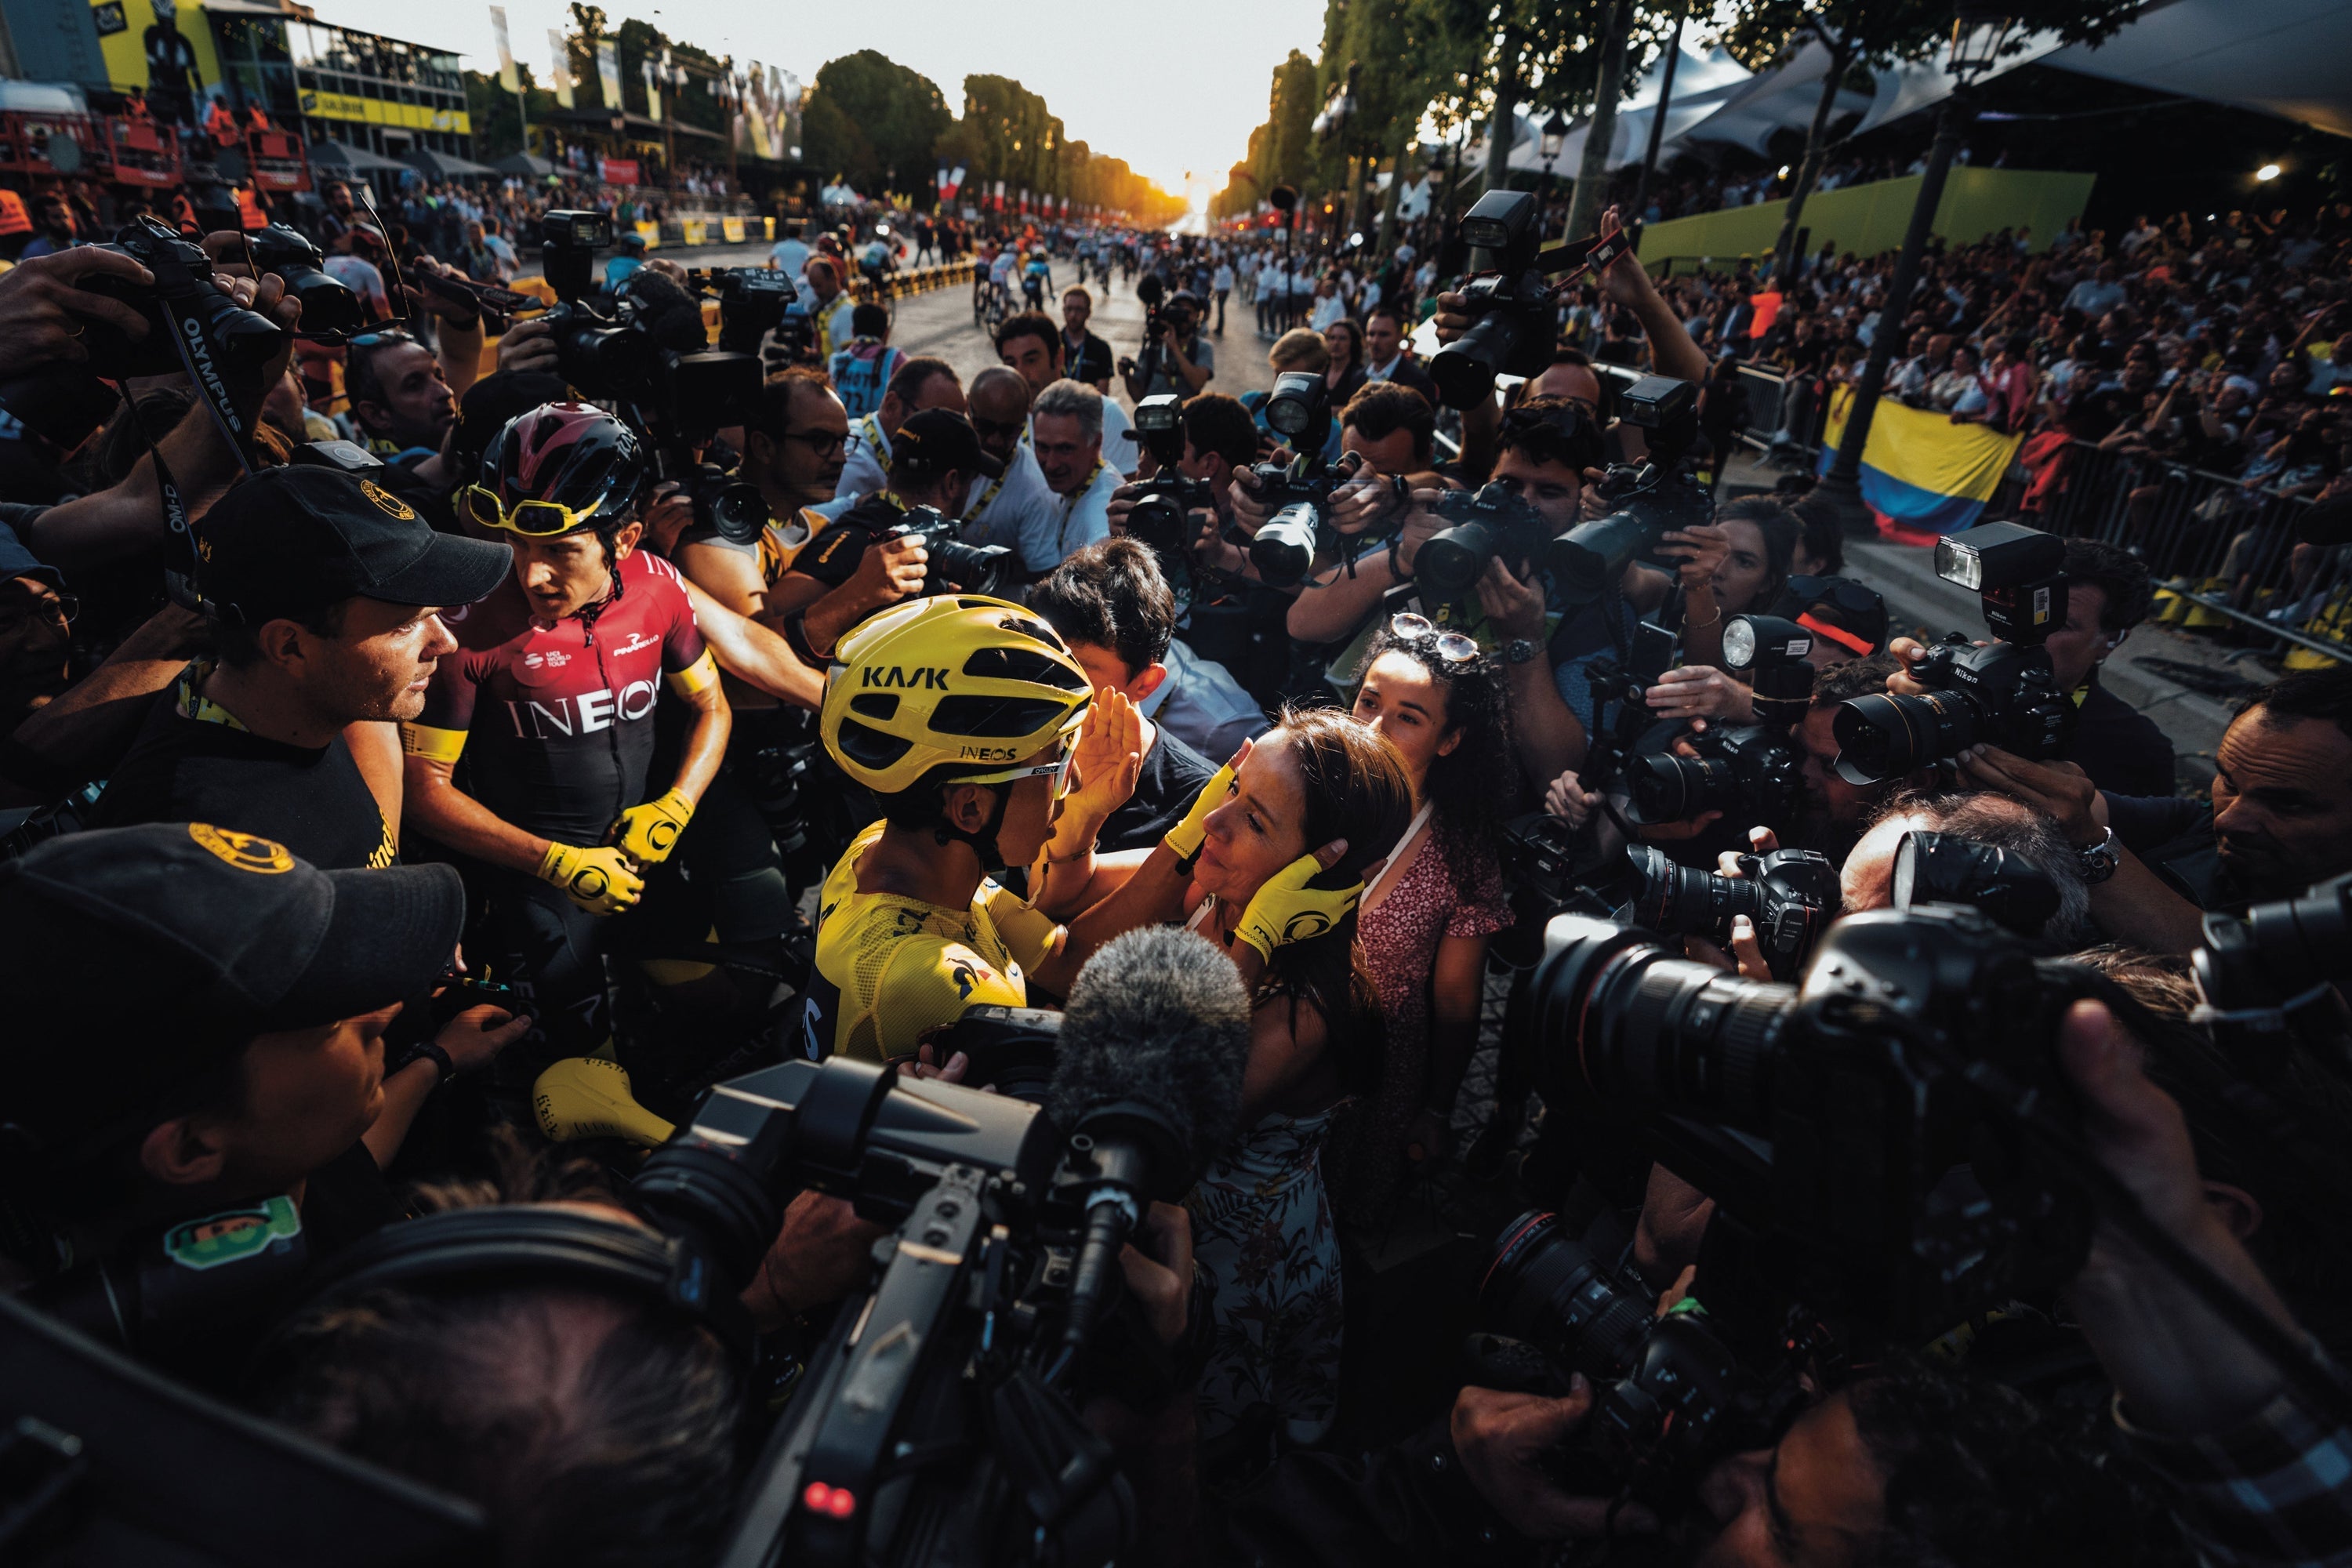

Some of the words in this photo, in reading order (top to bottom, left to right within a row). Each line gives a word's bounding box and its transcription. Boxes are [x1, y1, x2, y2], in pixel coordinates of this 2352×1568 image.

[183, 318, 241, 432] OLYMPUS
[165, 484, 186, 533] OM-D
[1991, 611, 2007, 620] Nikon
[613, 634, 659, 657] PINARELLO
[862, 666, 950, 691] KASK
[1955, 668, 1978, 684] Nikon
[960, 746, 1017, 760] INEOS
[1722, 741, 1739, 755] Nikon
